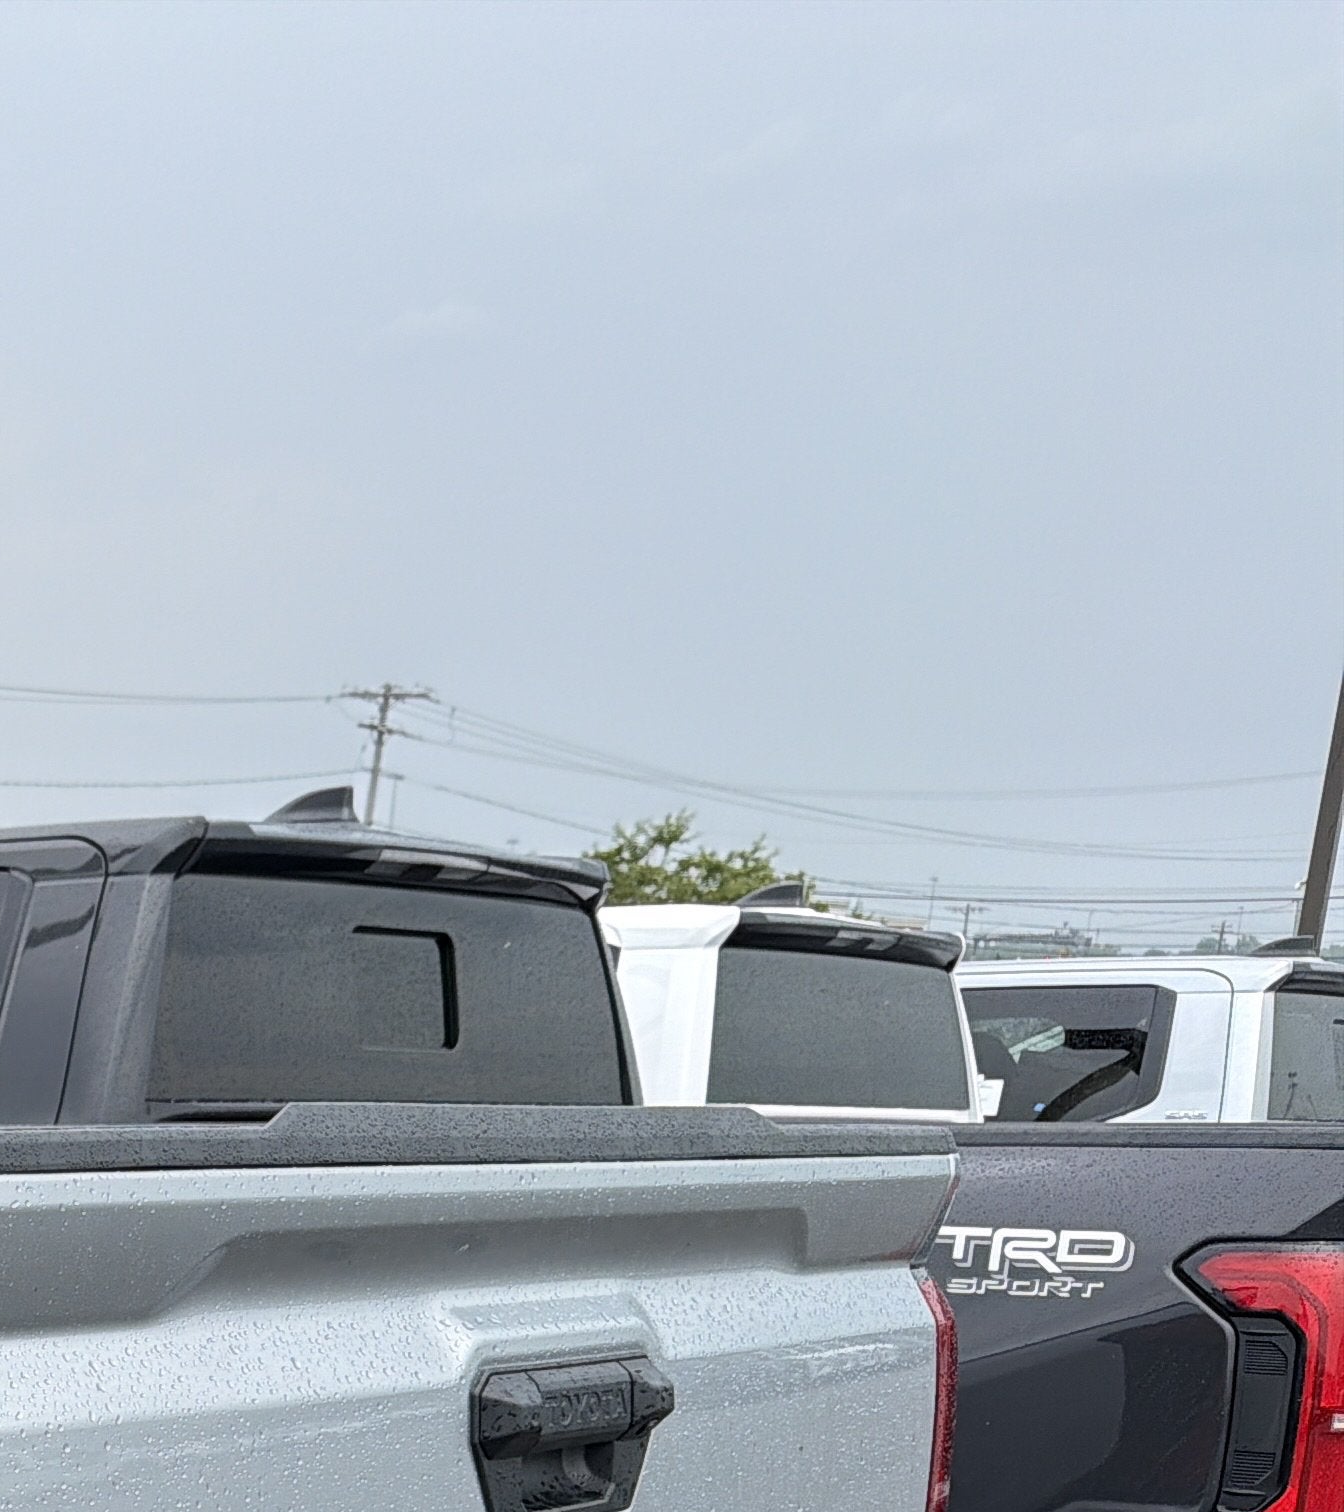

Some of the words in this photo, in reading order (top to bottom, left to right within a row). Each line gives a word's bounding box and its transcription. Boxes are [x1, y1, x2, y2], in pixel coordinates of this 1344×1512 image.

[935, 1226, 1135, 1276] TRD
[947, 1276, 1105, 1298] SPORT
[544, 1384, 628, 1427] TOYOTA
